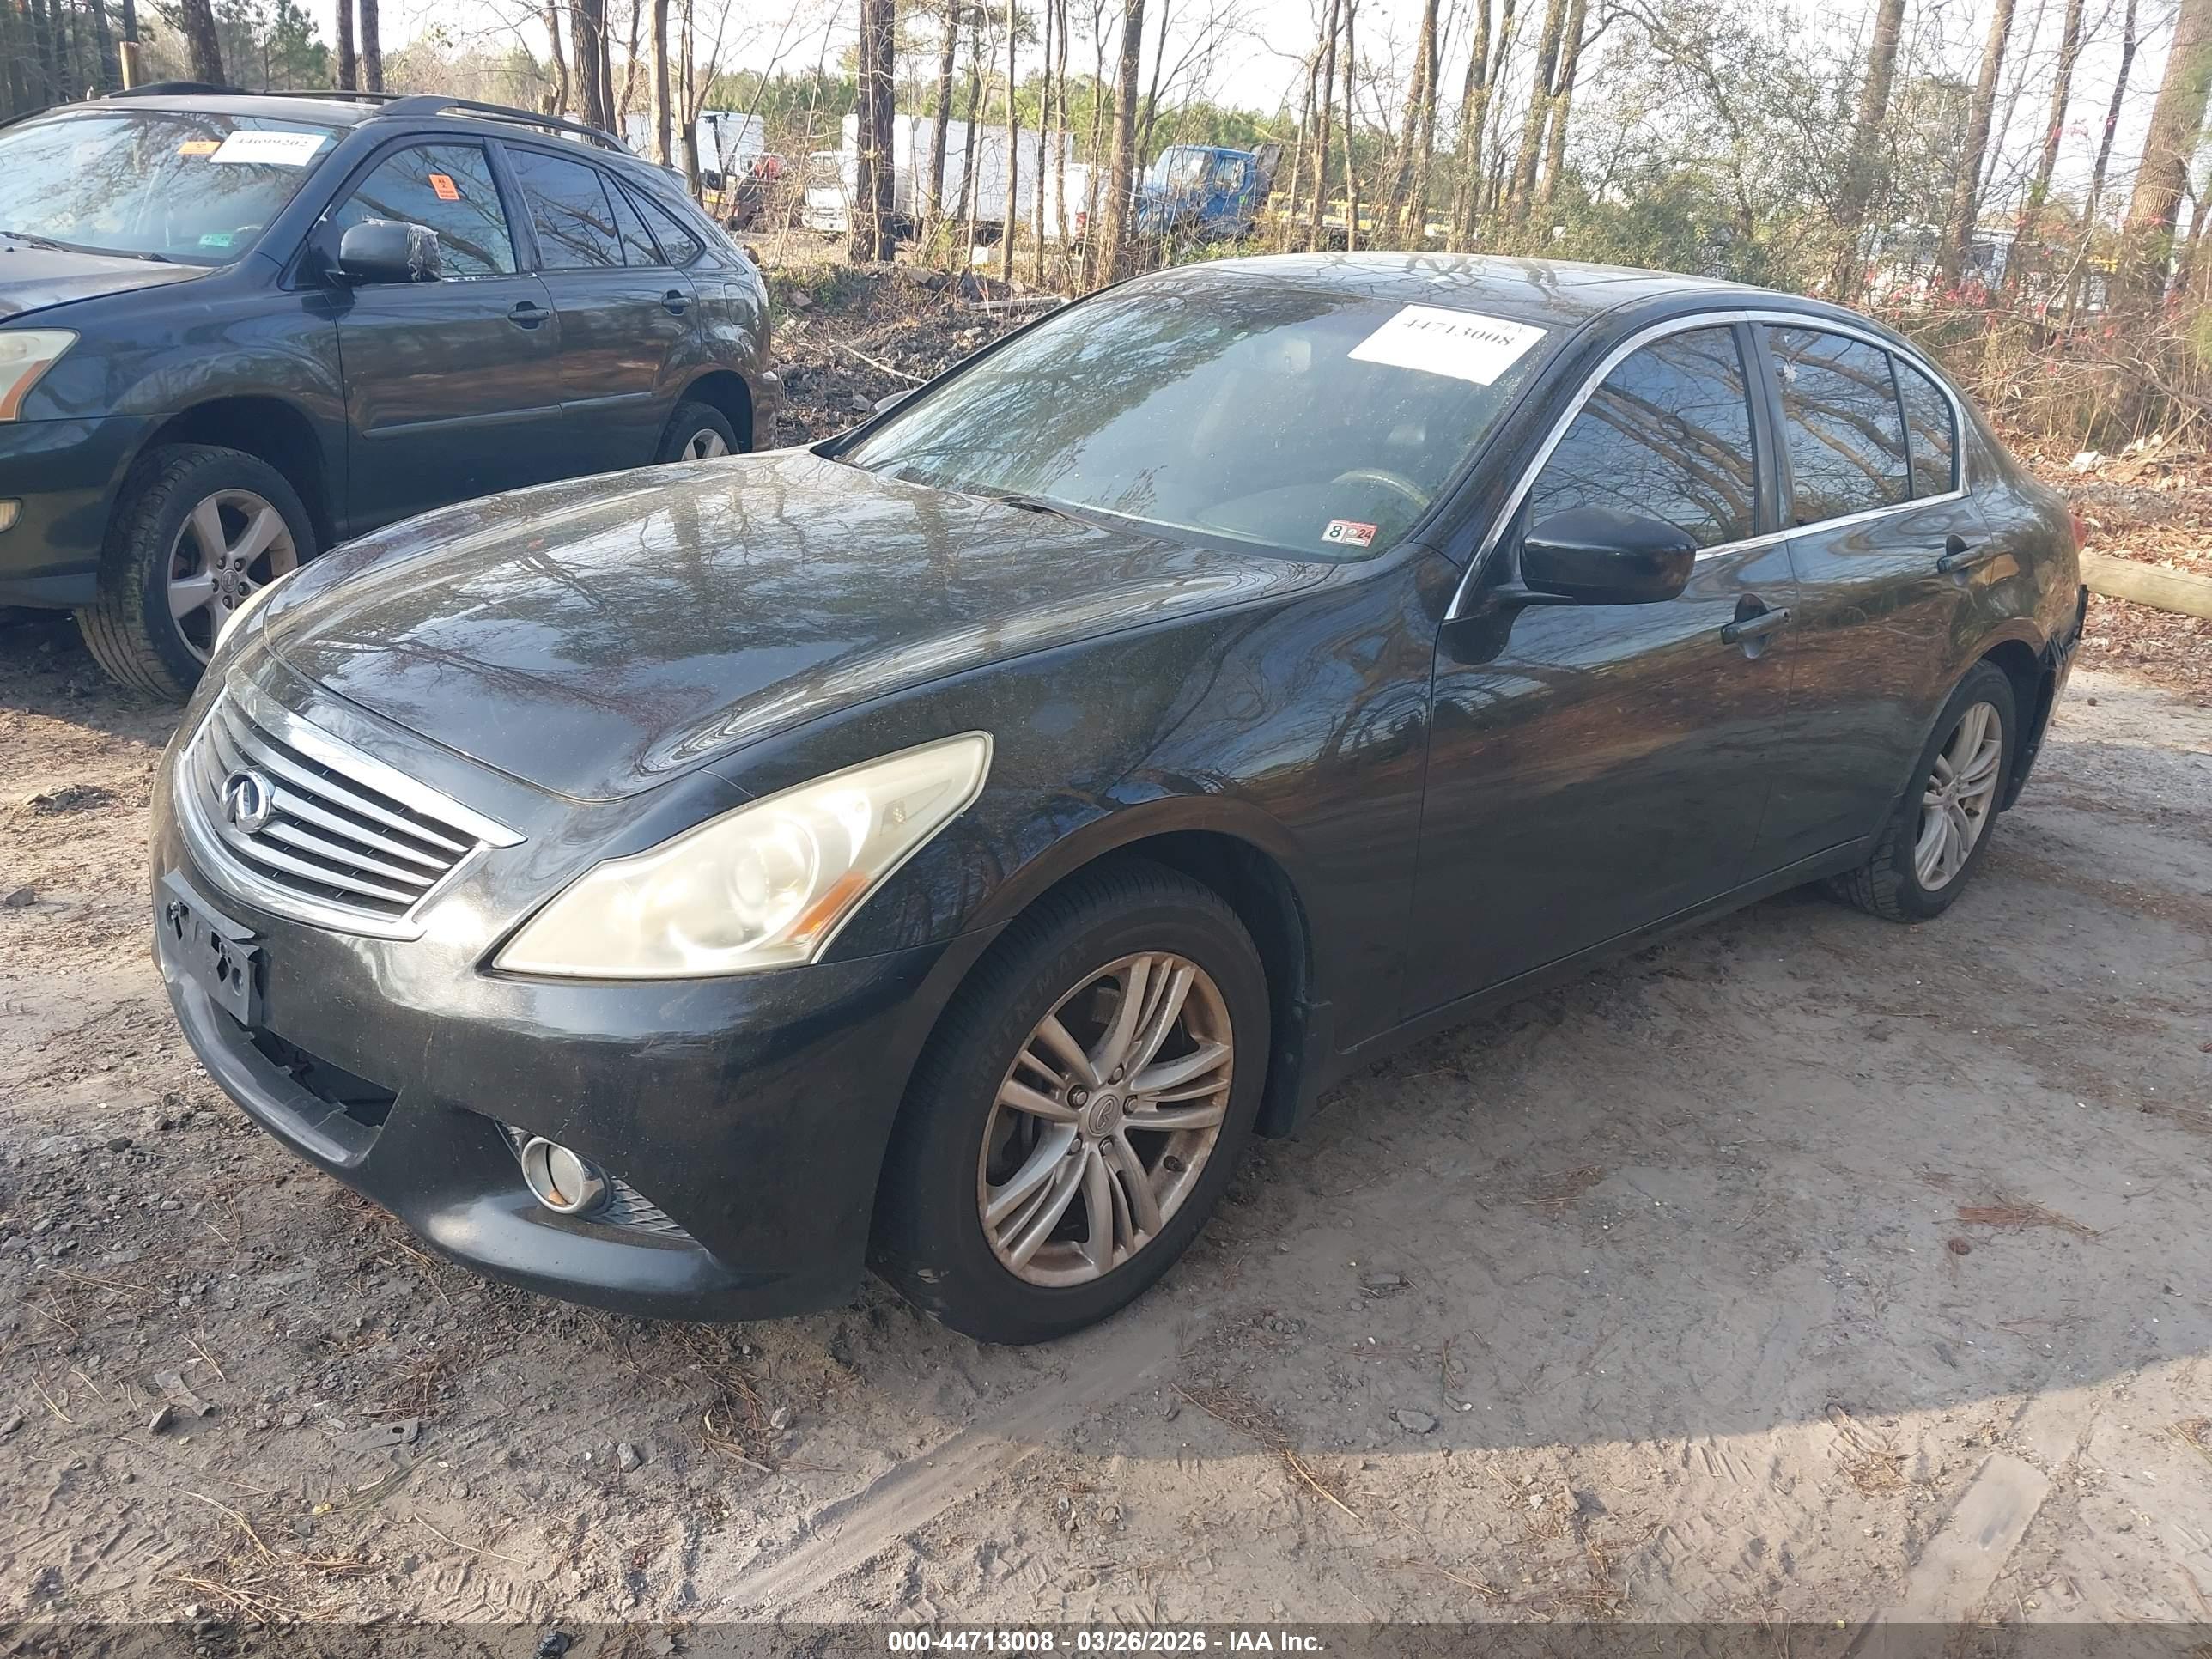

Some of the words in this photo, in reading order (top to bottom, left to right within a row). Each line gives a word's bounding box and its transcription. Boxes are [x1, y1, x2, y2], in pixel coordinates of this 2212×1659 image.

[1402, 319, 1516, 346] 44713008
[1329, 525, 1343, 538] 8
[1357, 528, 1373, 539] 24
